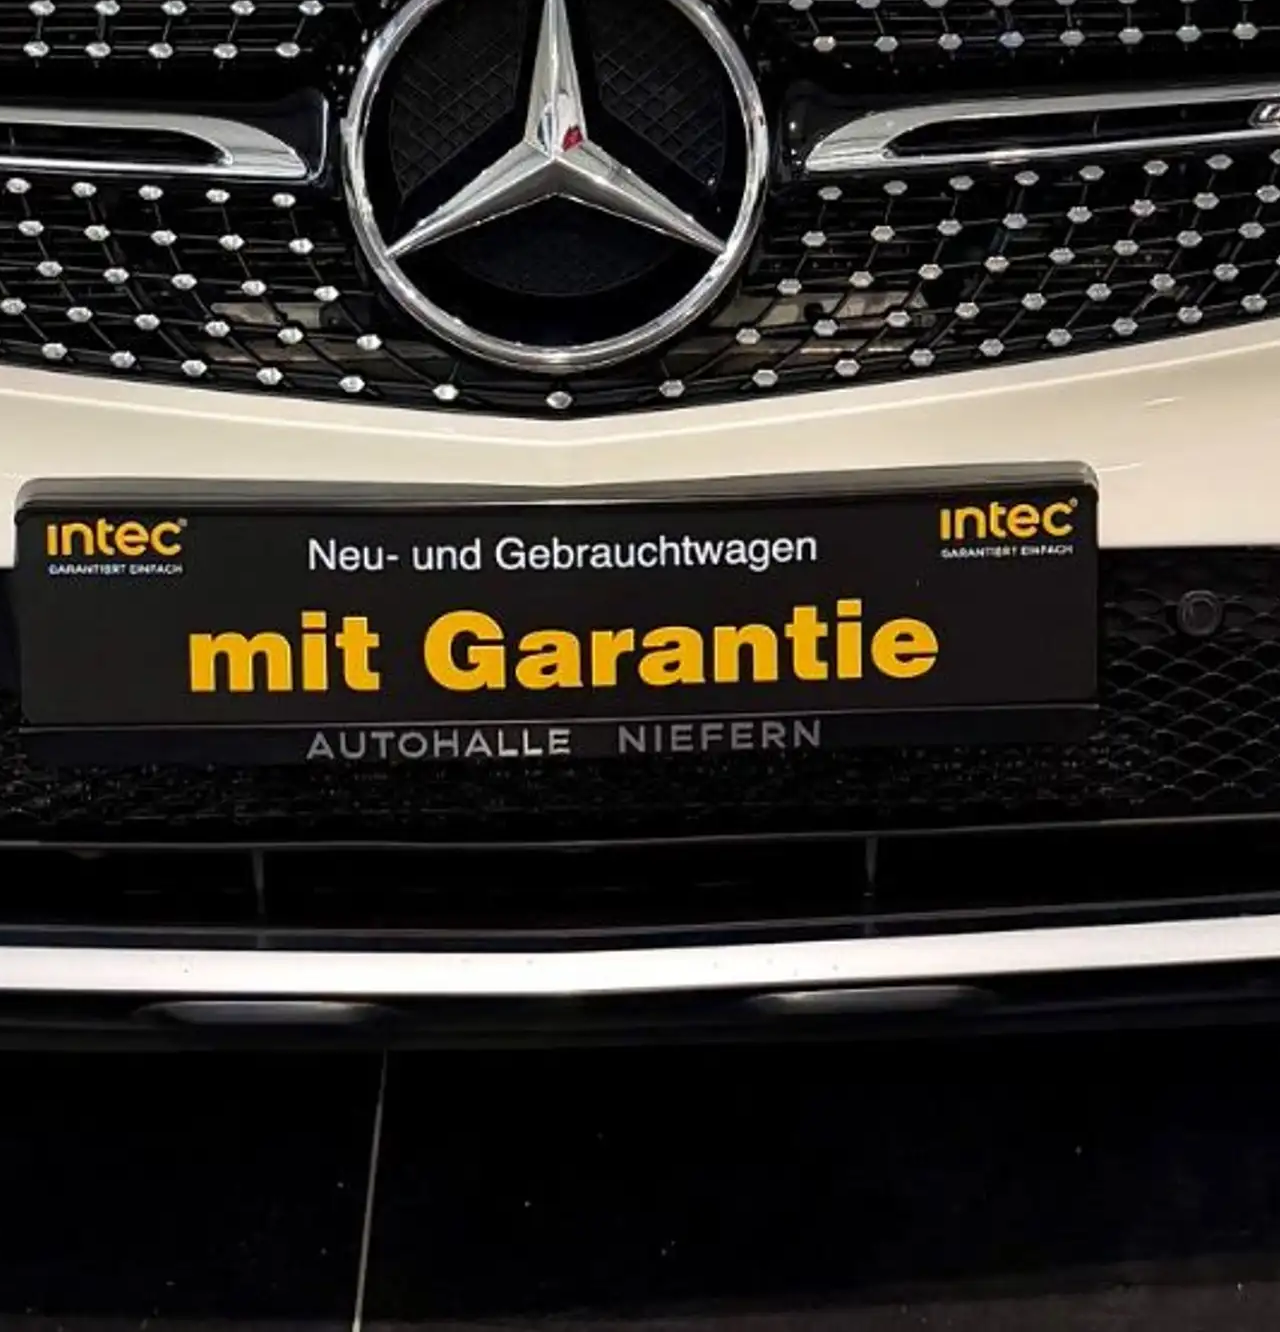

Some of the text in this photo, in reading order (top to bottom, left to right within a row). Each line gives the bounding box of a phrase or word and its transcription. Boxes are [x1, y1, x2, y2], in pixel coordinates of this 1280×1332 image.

[47, 518, 182, 556] intec
[940, 501, 1073, 540] intec
[308, 535, 818, 572] Neu- und Gebrauchtwagen
[188, 598, 939, 693] mit Garantie
[306, 720, 822, 760] AUTOHALLE NIEFERN
